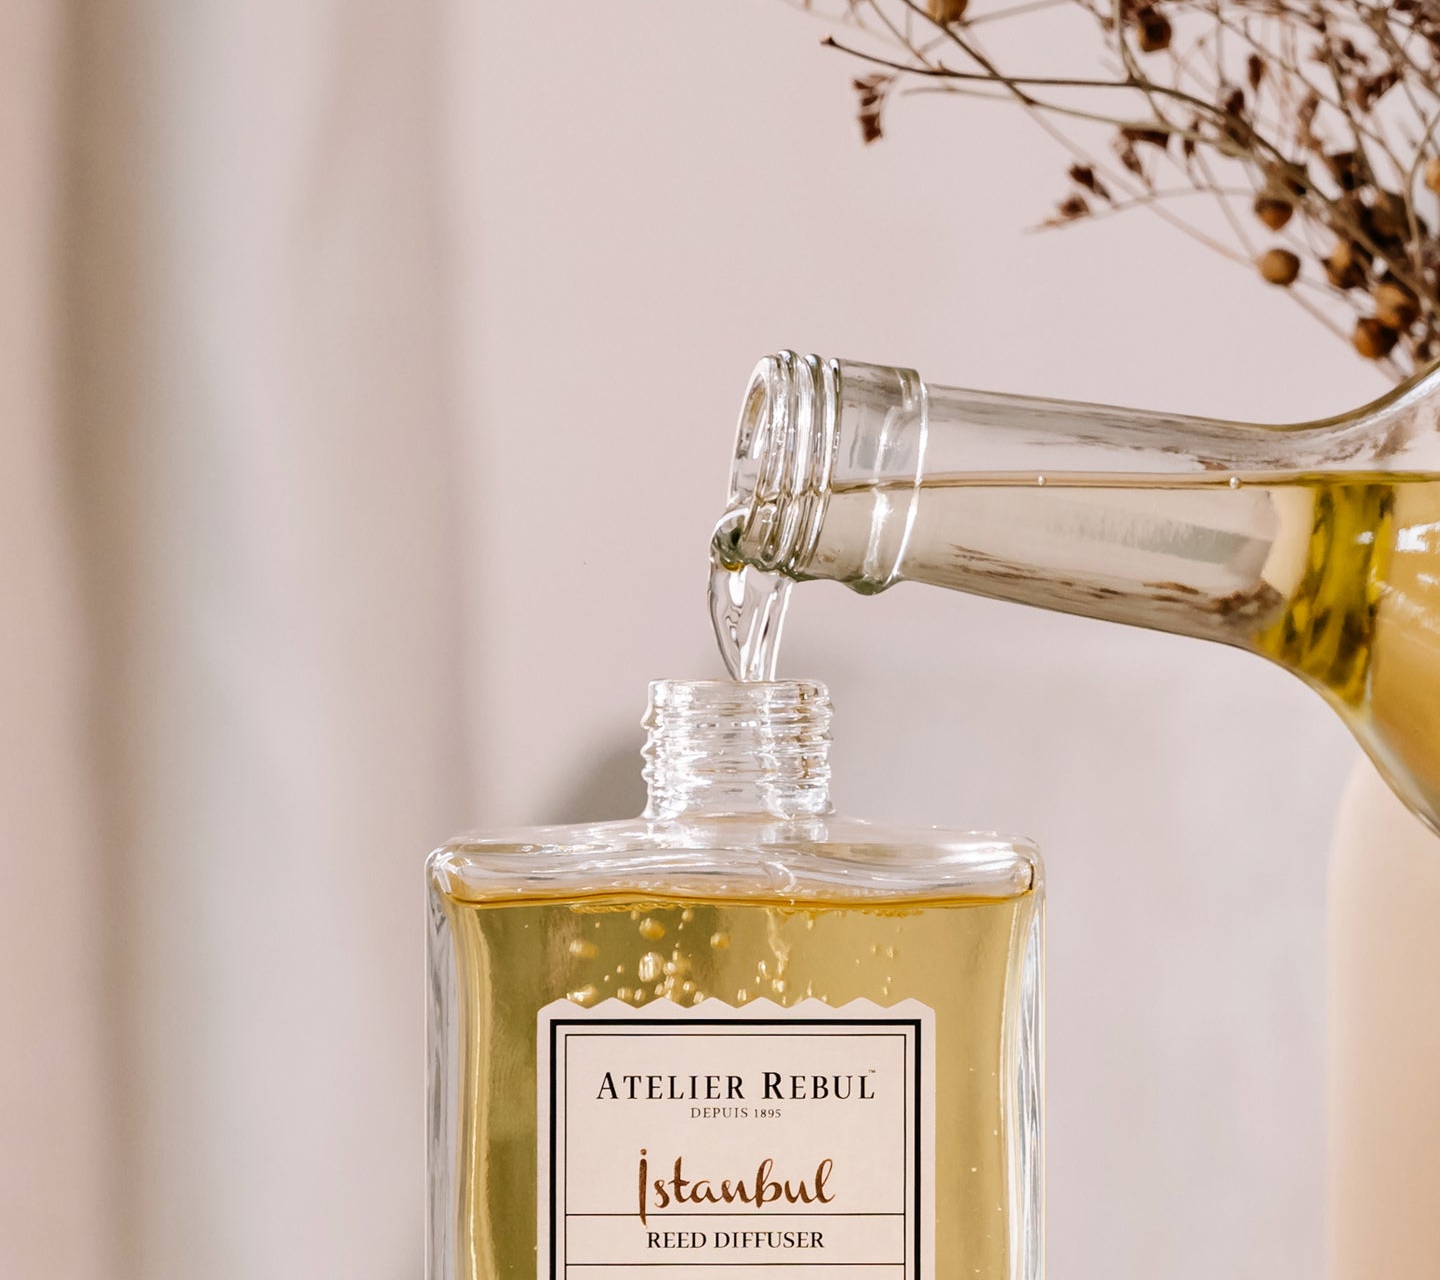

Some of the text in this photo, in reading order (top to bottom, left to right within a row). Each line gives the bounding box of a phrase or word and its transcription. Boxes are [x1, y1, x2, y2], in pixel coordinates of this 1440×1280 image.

[596, 1070, 877, 1100] ATELIER REBUL
[690, 1106, 782, 1119] DEPUIS 1895
[646, 1231, 825, 1249] REED DIFFUSER
